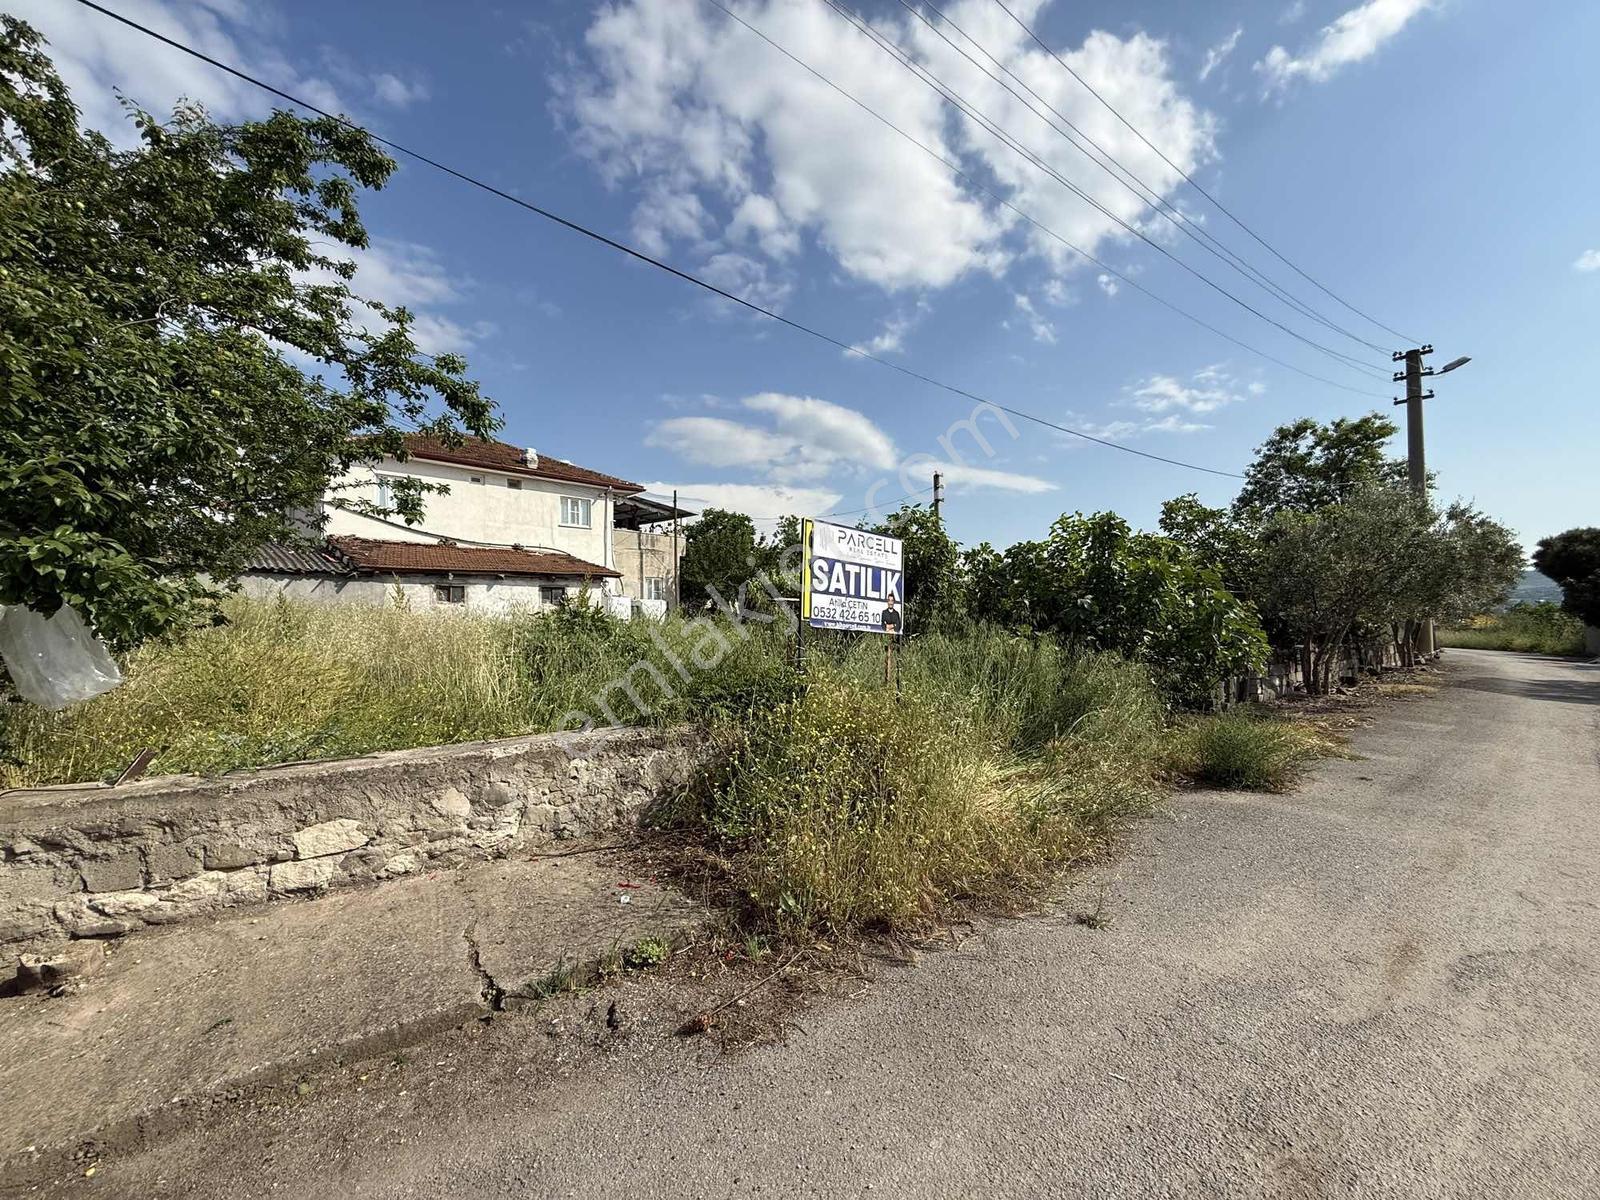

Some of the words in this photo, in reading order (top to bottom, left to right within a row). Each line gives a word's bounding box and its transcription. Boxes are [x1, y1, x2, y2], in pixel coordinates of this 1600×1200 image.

[838, 529, 898, 555] PARCELL
[812, 558, 901, 602] SATILIK
[813, 606, 837, 619] 0532
[839, 609, 857, 621] 424
[858, 611, 870, 622] 65
[872, 612, 881, 624] 10
